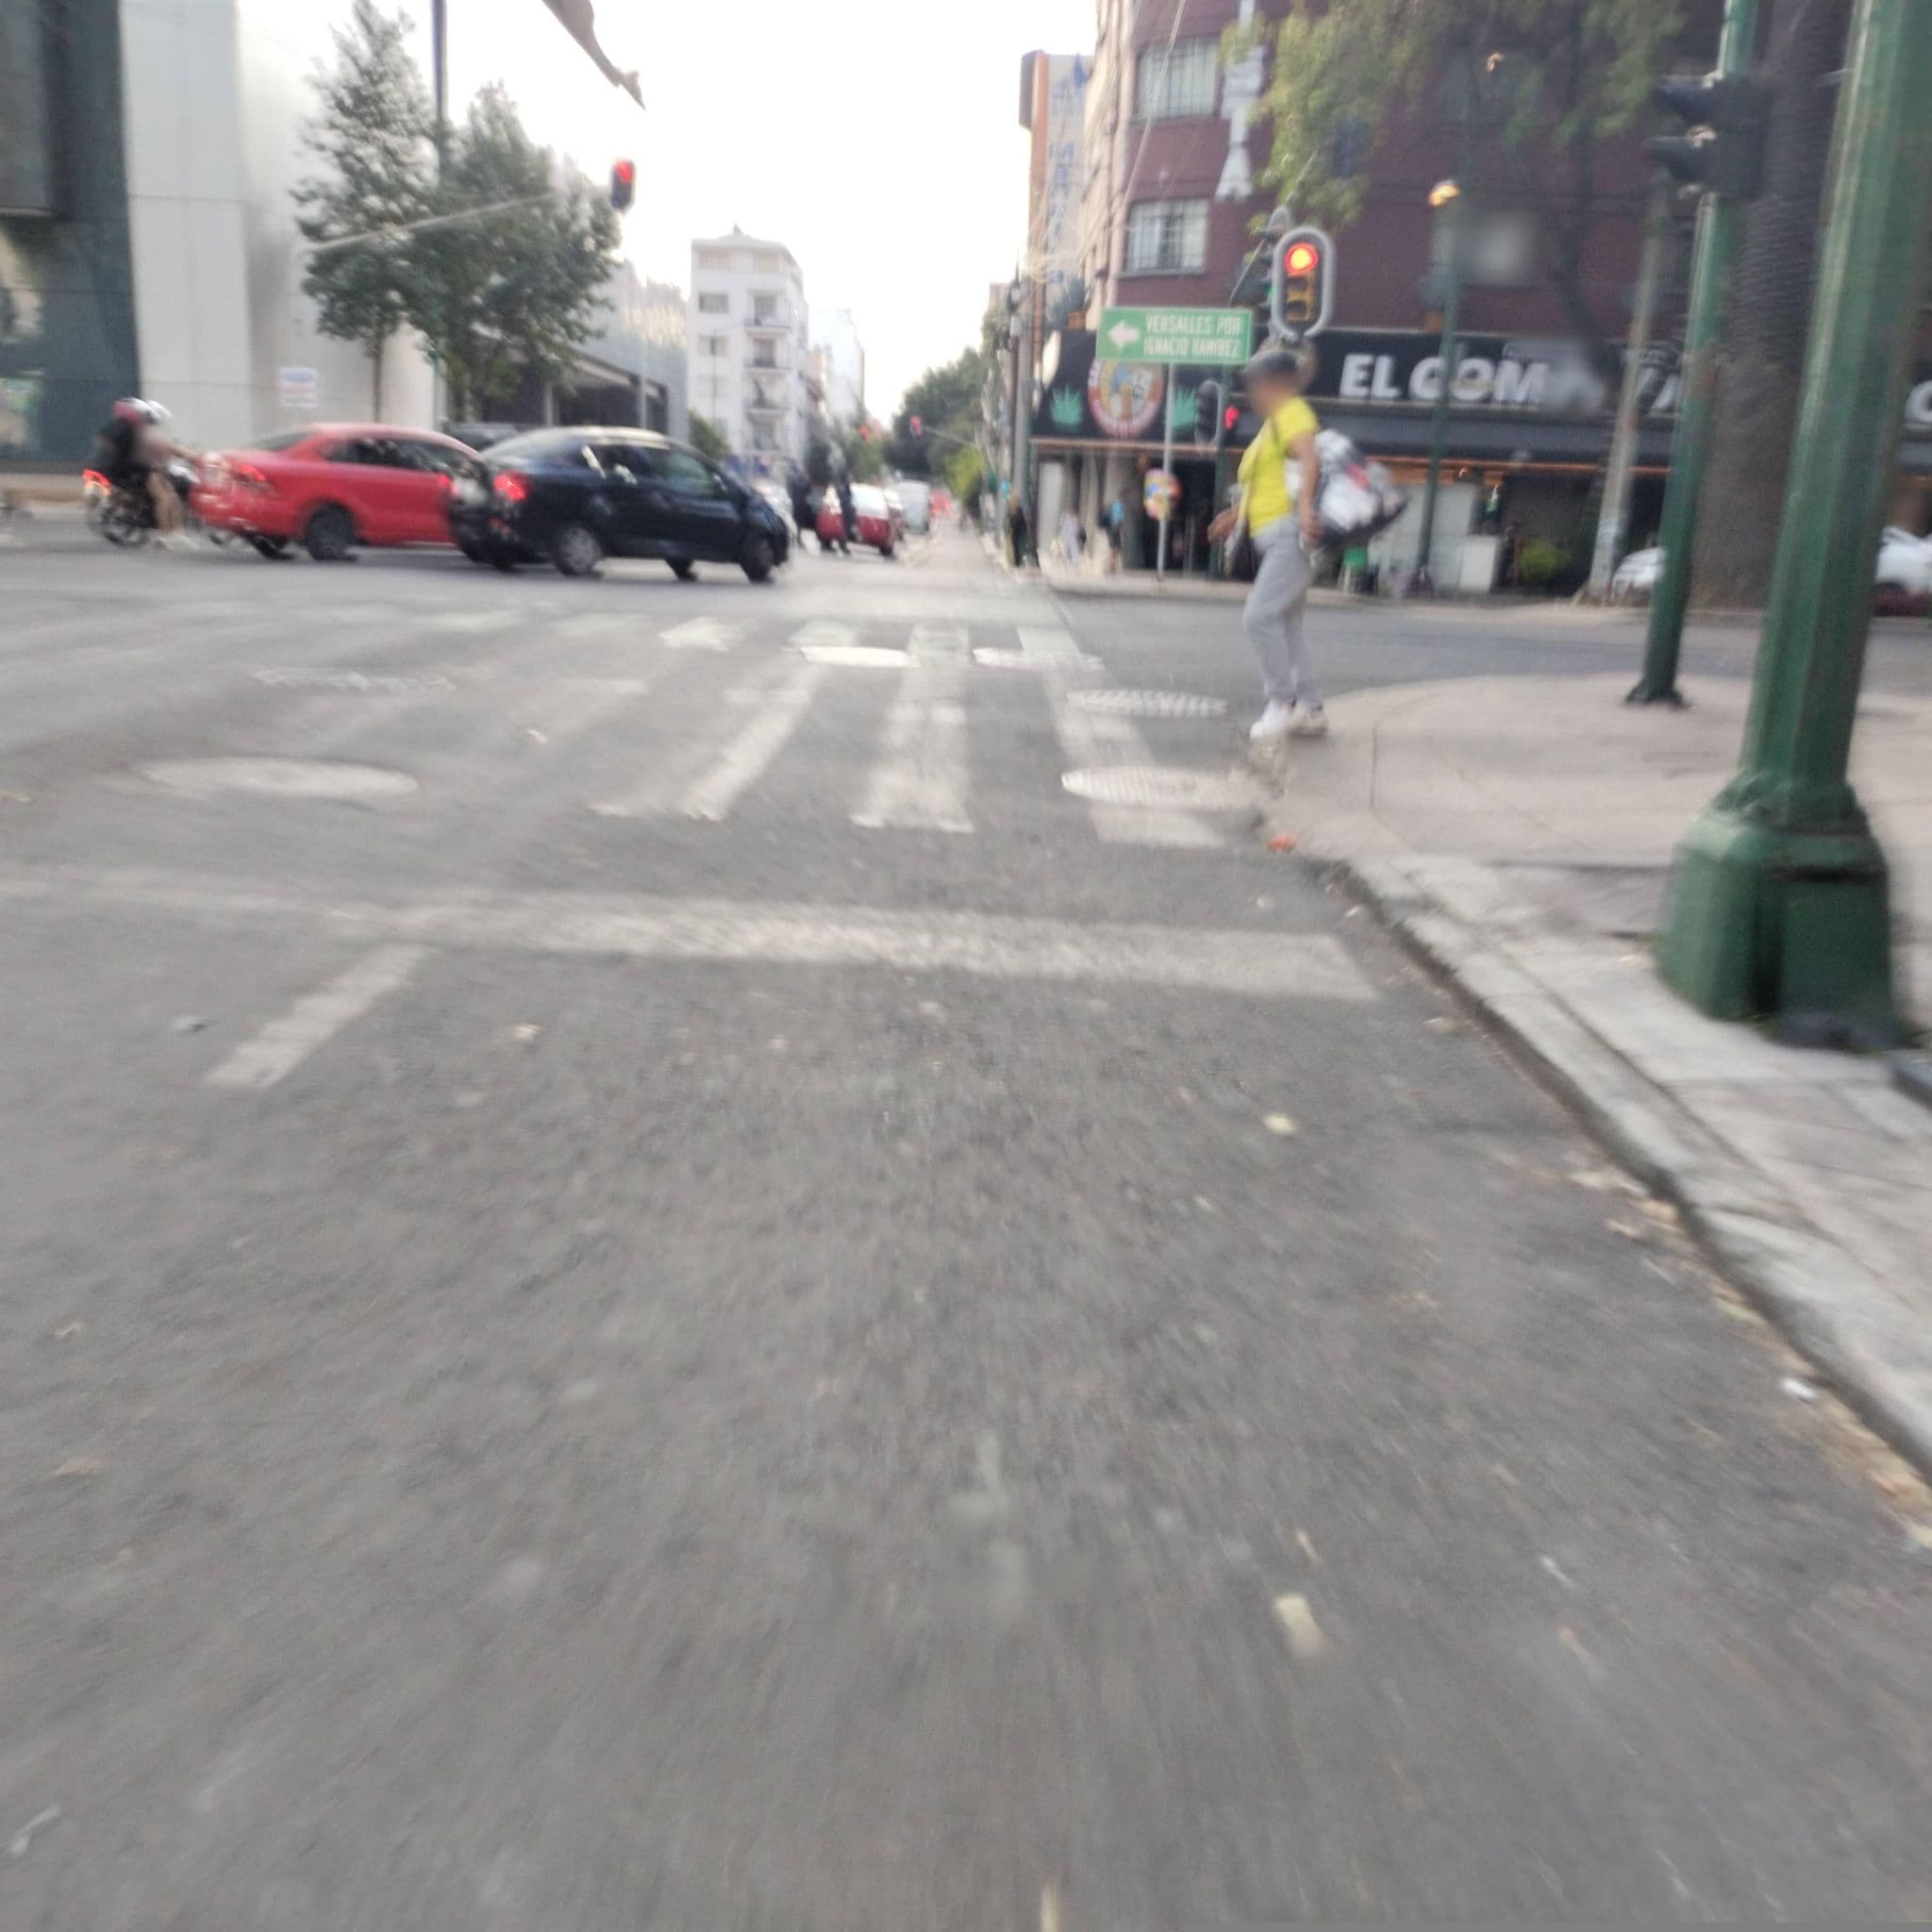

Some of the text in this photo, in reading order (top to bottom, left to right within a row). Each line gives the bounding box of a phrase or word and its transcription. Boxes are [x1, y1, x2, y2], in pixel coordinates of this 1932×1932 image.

[1146, 315, 1241, 334] VERSALLES POR
[1143, 337, 1241, 357] IGNACIO RAMIREZ
[1340, 353, 1400, 398] EL
